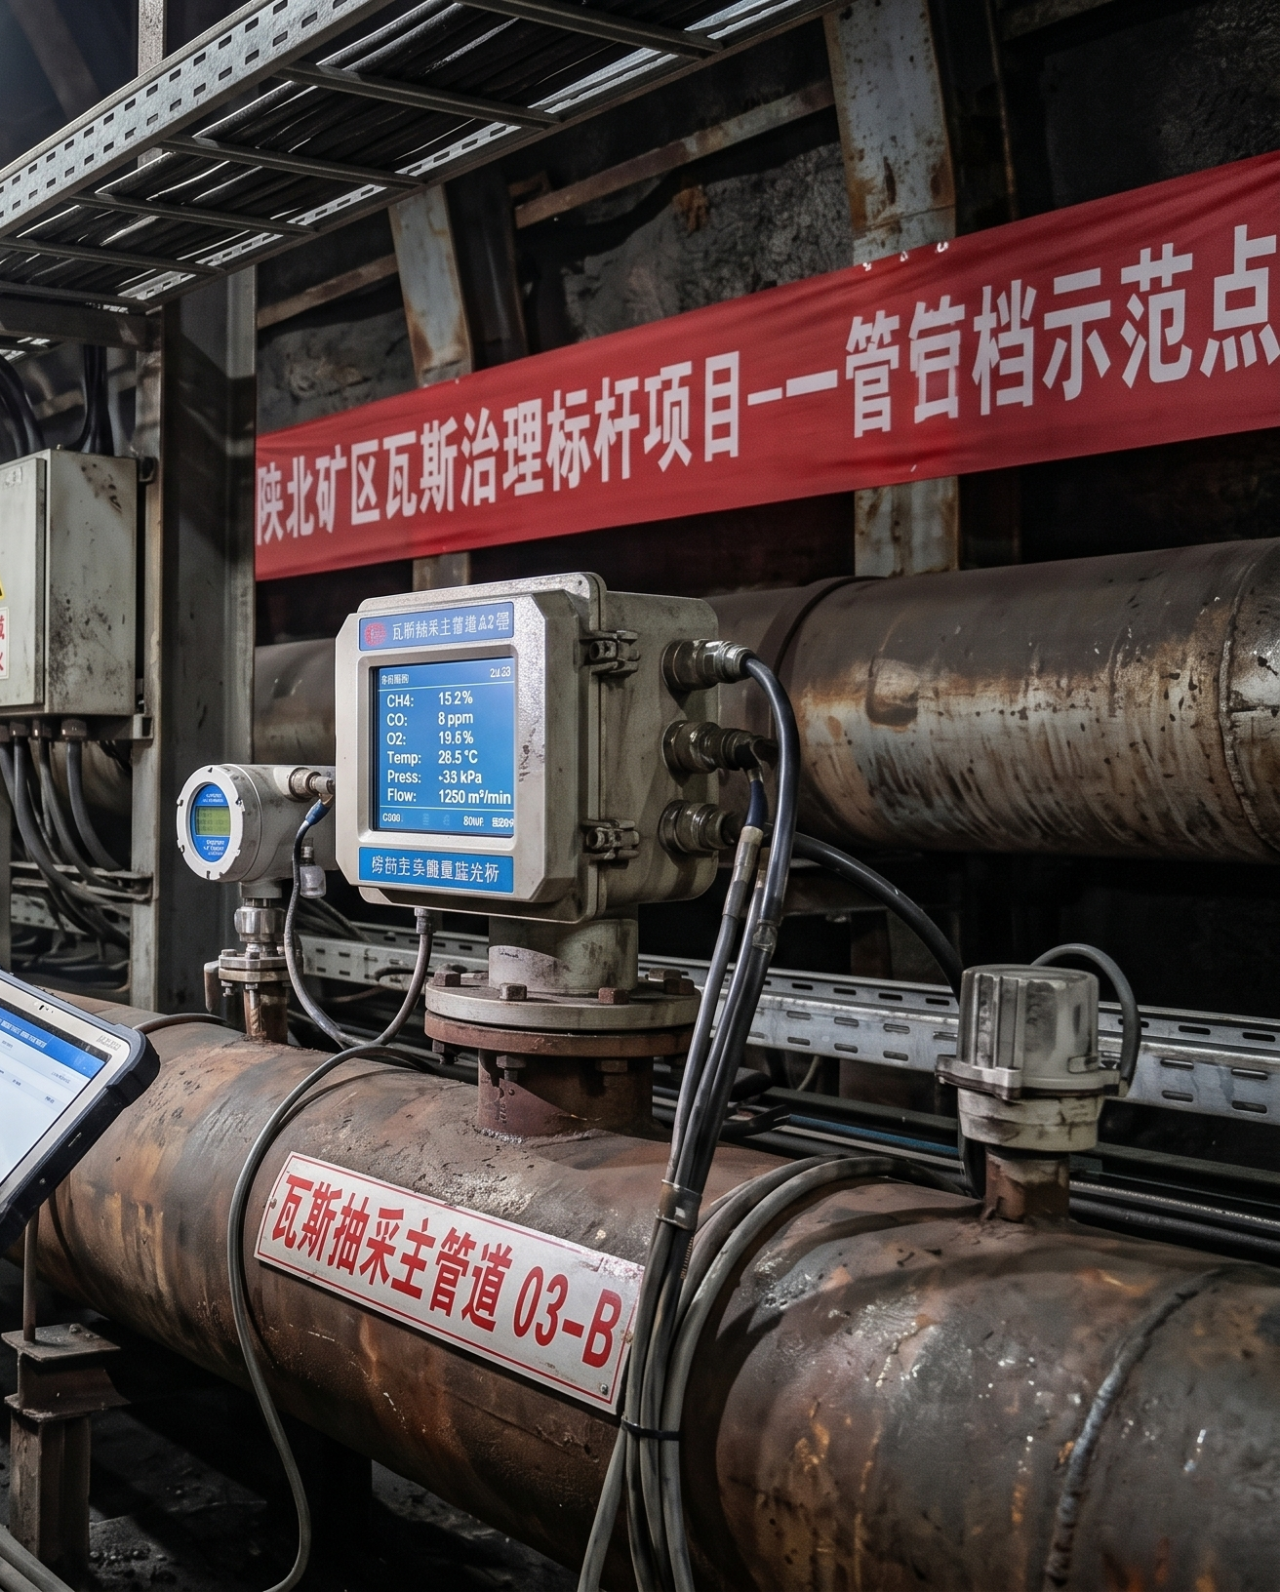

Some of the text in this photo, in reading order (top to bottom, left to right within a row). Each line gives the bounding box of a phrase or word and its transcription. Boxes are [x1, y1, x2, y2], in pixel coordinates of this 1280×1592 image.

[386, 694, 415, 708] CH4:
[386, 711, 474, 728] CO: 8 ppm
[386, 732, 407, 745] O2:
[387, 751, 422, 767] Temp:
[438, 750, 462, 764] 28.5
[387, 769, 422, 783] Press:
[460, 769, 483, 784] kPa
[387, 788, 417, 802] Flow:
[438, 789, 466, 804] 1250
[271, 1174, 623, 1369] 瓦斯抽采主管道 03-B
